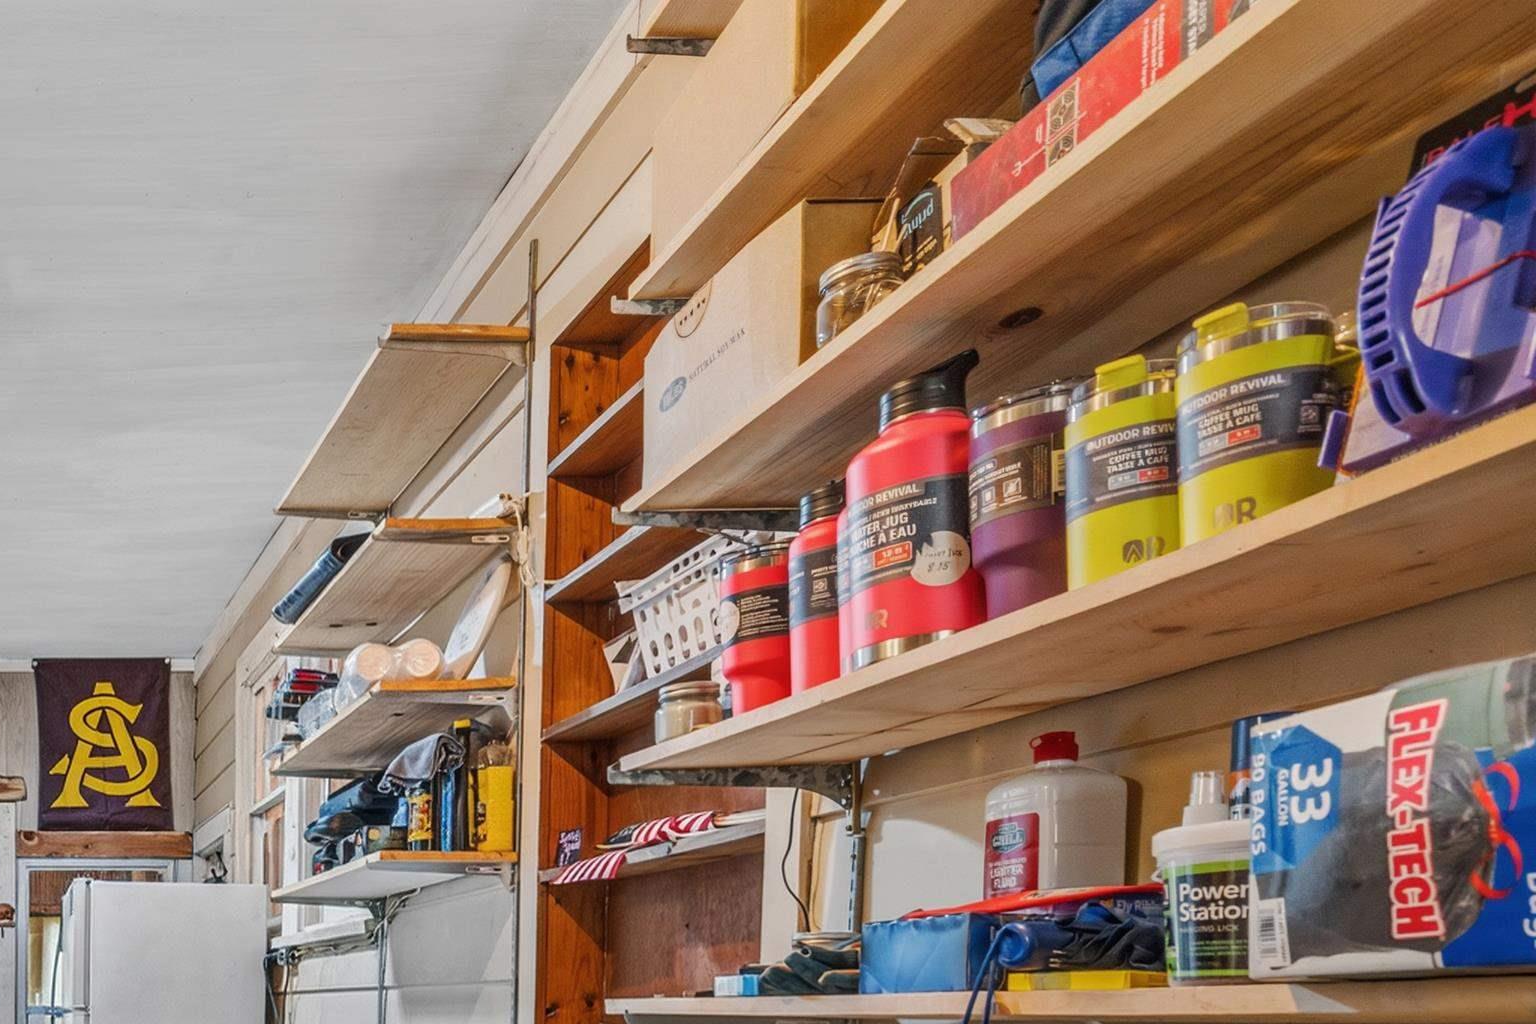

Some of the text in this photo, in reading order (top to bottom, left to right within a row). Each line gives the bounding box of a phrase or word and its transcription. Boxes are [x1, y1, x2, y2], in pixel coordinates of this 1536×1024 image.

[1230, 374, 1284, 395] REVIVAL
[1232, 403, 1259, 418] MUG
[875, 483, 920, 505] REVIVAL
[882, 511, 909, 530] JUG
[889, 524, 917, 541] EAU
[1277, 768, 1289, 827] GALLON
[1291, 758, 1333, 824] 33
[1252, 788, 1266, 857] BAGS
[1387, 699, 1448, 940] FLEX-TECH
[1179, 883, 1249, 902] Power
